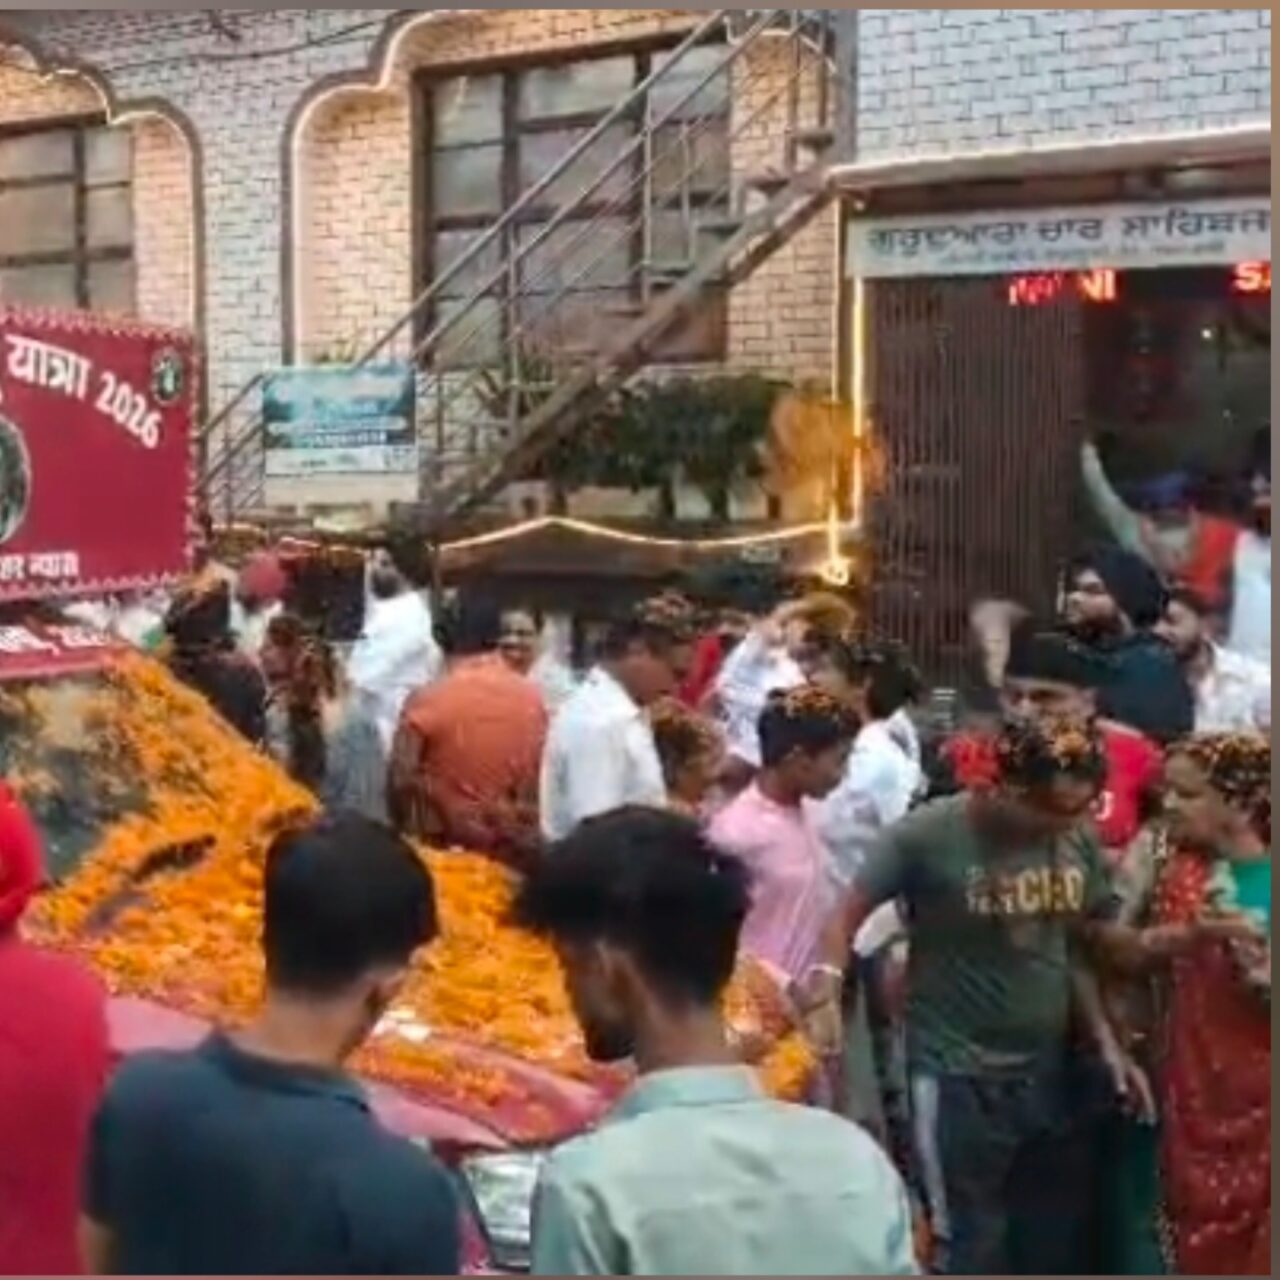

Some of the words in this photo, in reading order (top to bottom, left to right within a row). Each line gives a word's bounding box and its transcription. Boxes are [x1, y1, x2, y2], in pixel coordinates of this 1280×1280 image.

[1121, 207, 1271, 237] ਸਾਹਿਬਜ
[5, 333, 93, 404] यात्रा
[94, 370, 162, 449] 2026
